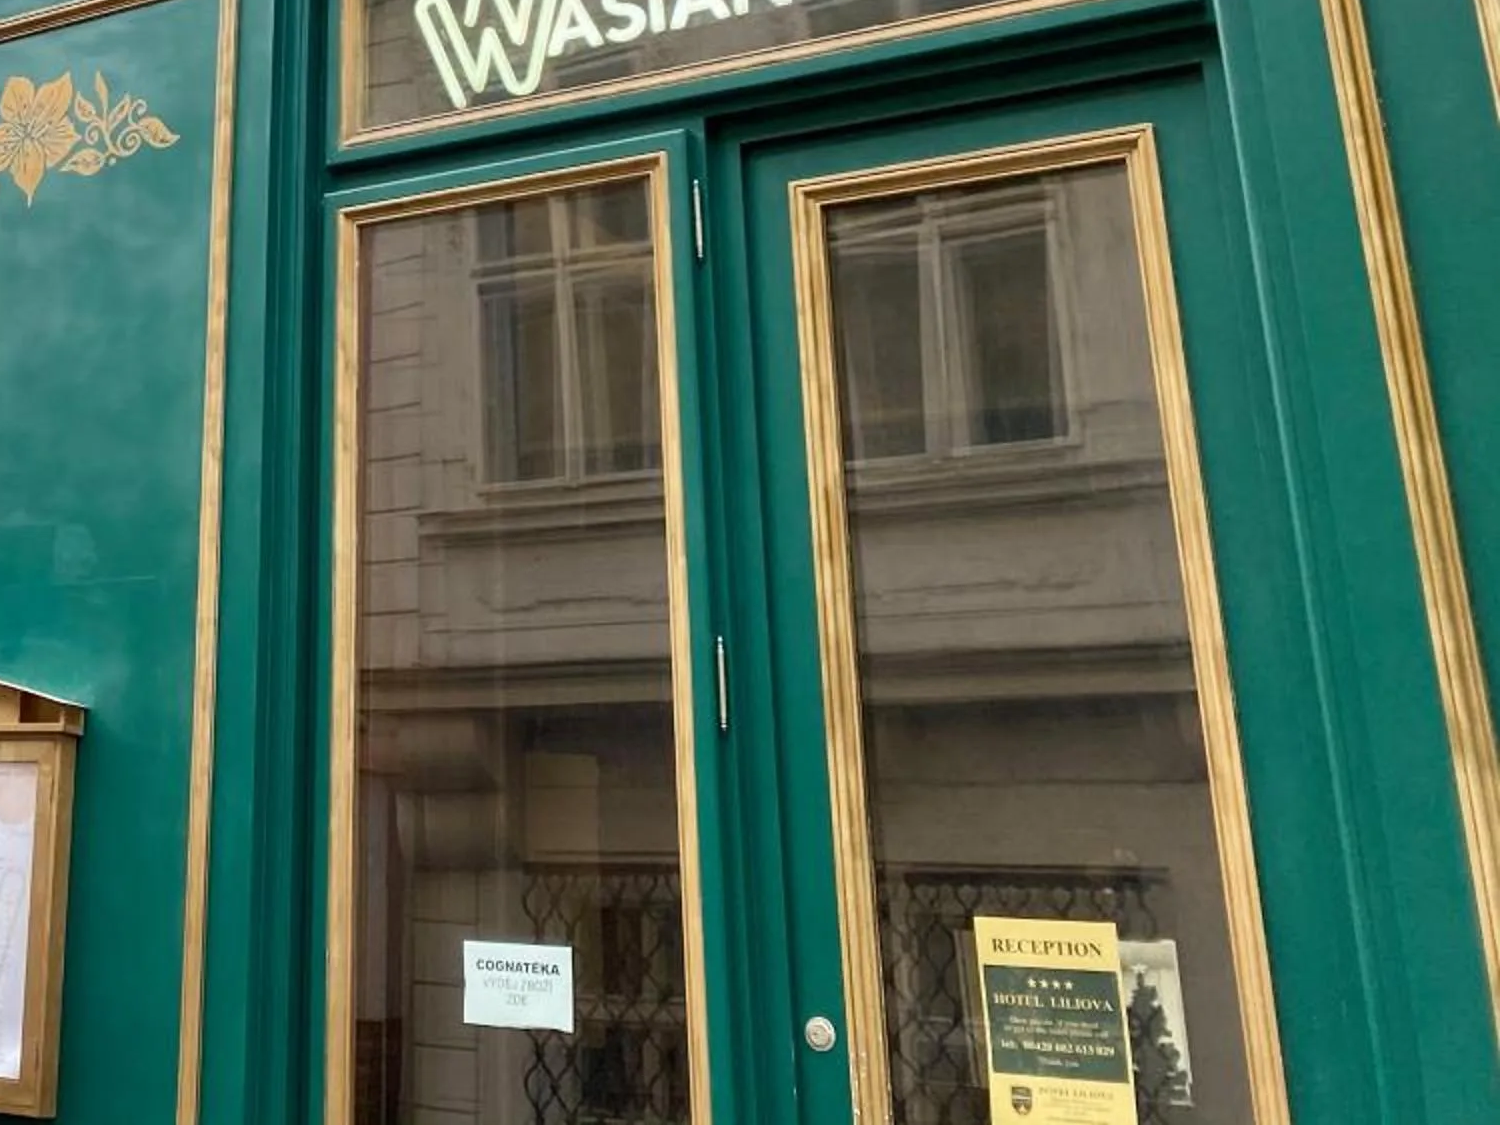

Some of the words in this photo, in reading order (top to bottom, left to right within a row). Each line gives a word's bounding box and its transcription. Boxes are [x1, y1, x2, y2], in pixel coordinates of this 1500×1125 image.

[991, 938, 1103, 957] RECEPTION
[476, 959, 560, 976] COGNATEKA
[993, 992, 1044, 1008] HOTEL
[1051, 996, 1115, 1012] LILIOVA
